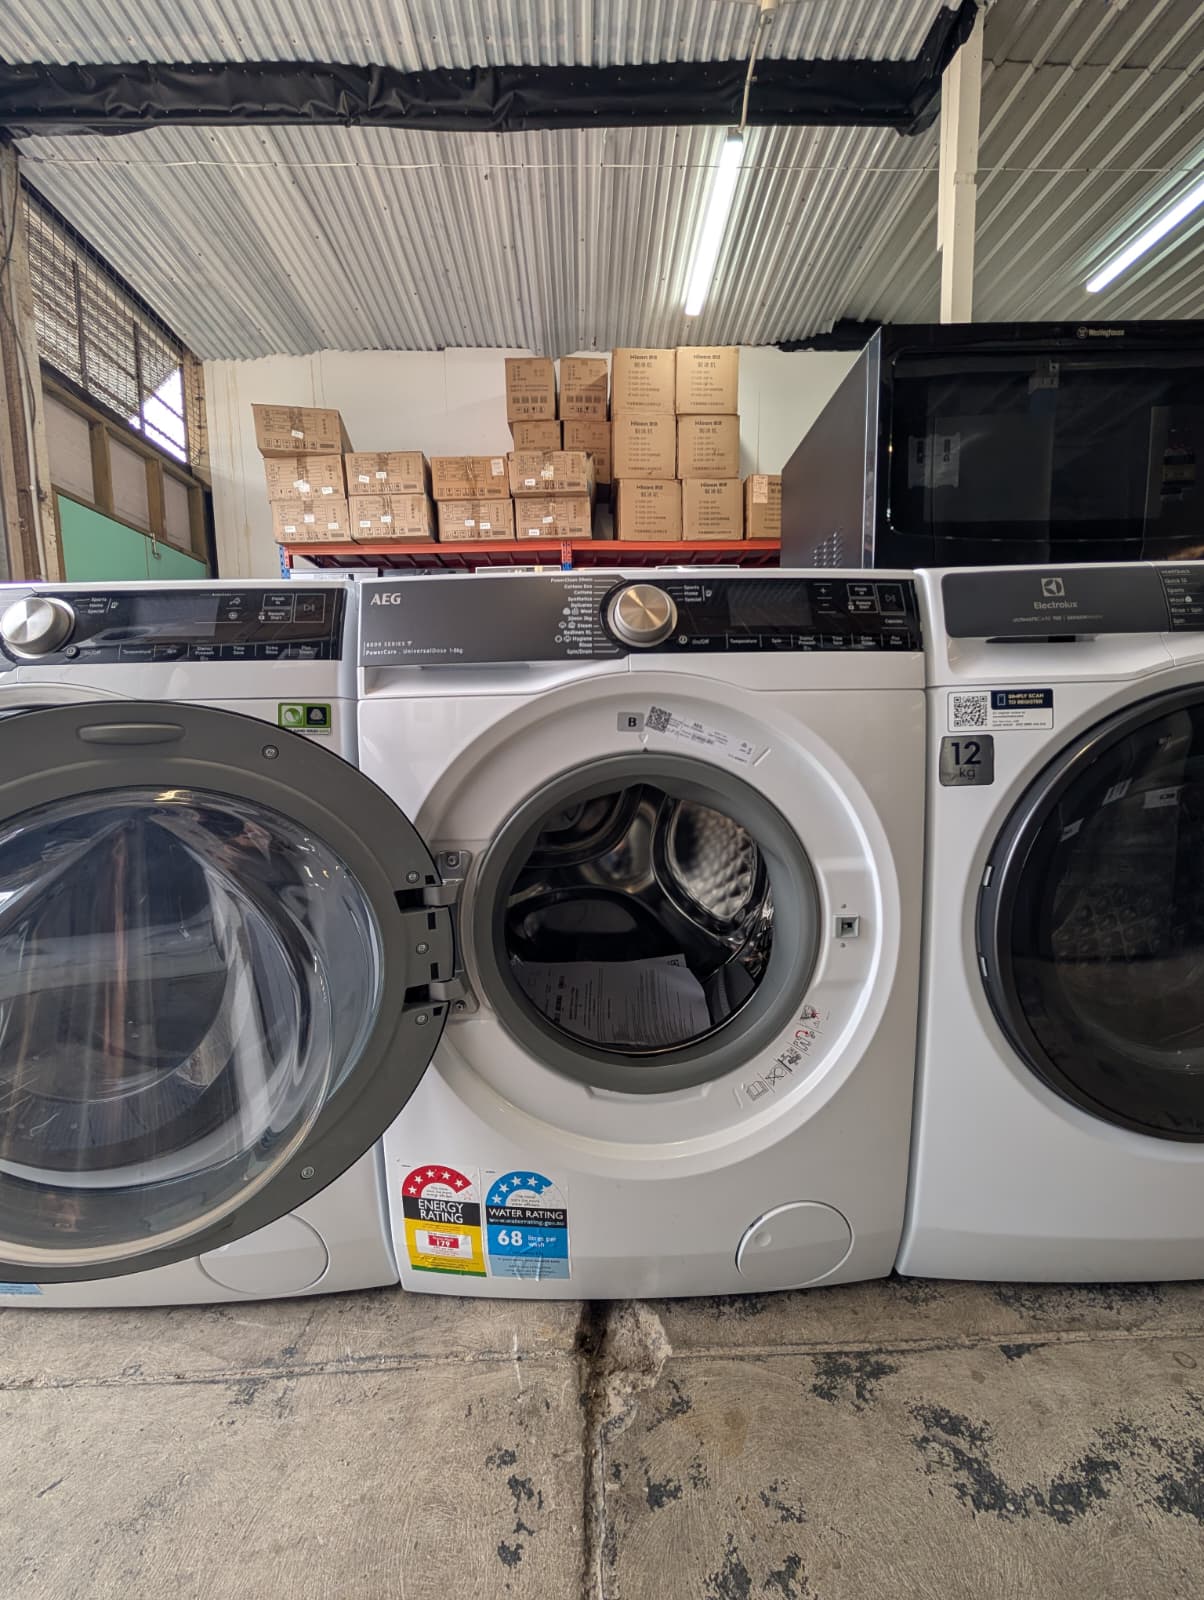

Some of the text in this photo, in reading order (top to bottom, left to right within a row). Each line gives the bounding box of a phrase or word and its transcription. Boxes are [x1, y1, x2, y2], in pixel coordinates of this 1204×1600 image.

[370, 593, 401, 606] AEG
[1033, 600, 1078, 609] Electrolux
[628, 717, 637, 728] B
[951, 741, 982, 766] 12
[959, 768, 976, 780] kg
[418, 1199, 464, 1213] ENERGY
[420, 1210, 463, 1224] RATING
[489, 1208, 564, 1220] WATER RATING
[489, 1218, 565, 1227] www.waterrating.gov.au
[498, 1229, 523, 1246] 68
[528, 1234, 544, 1242] litres
